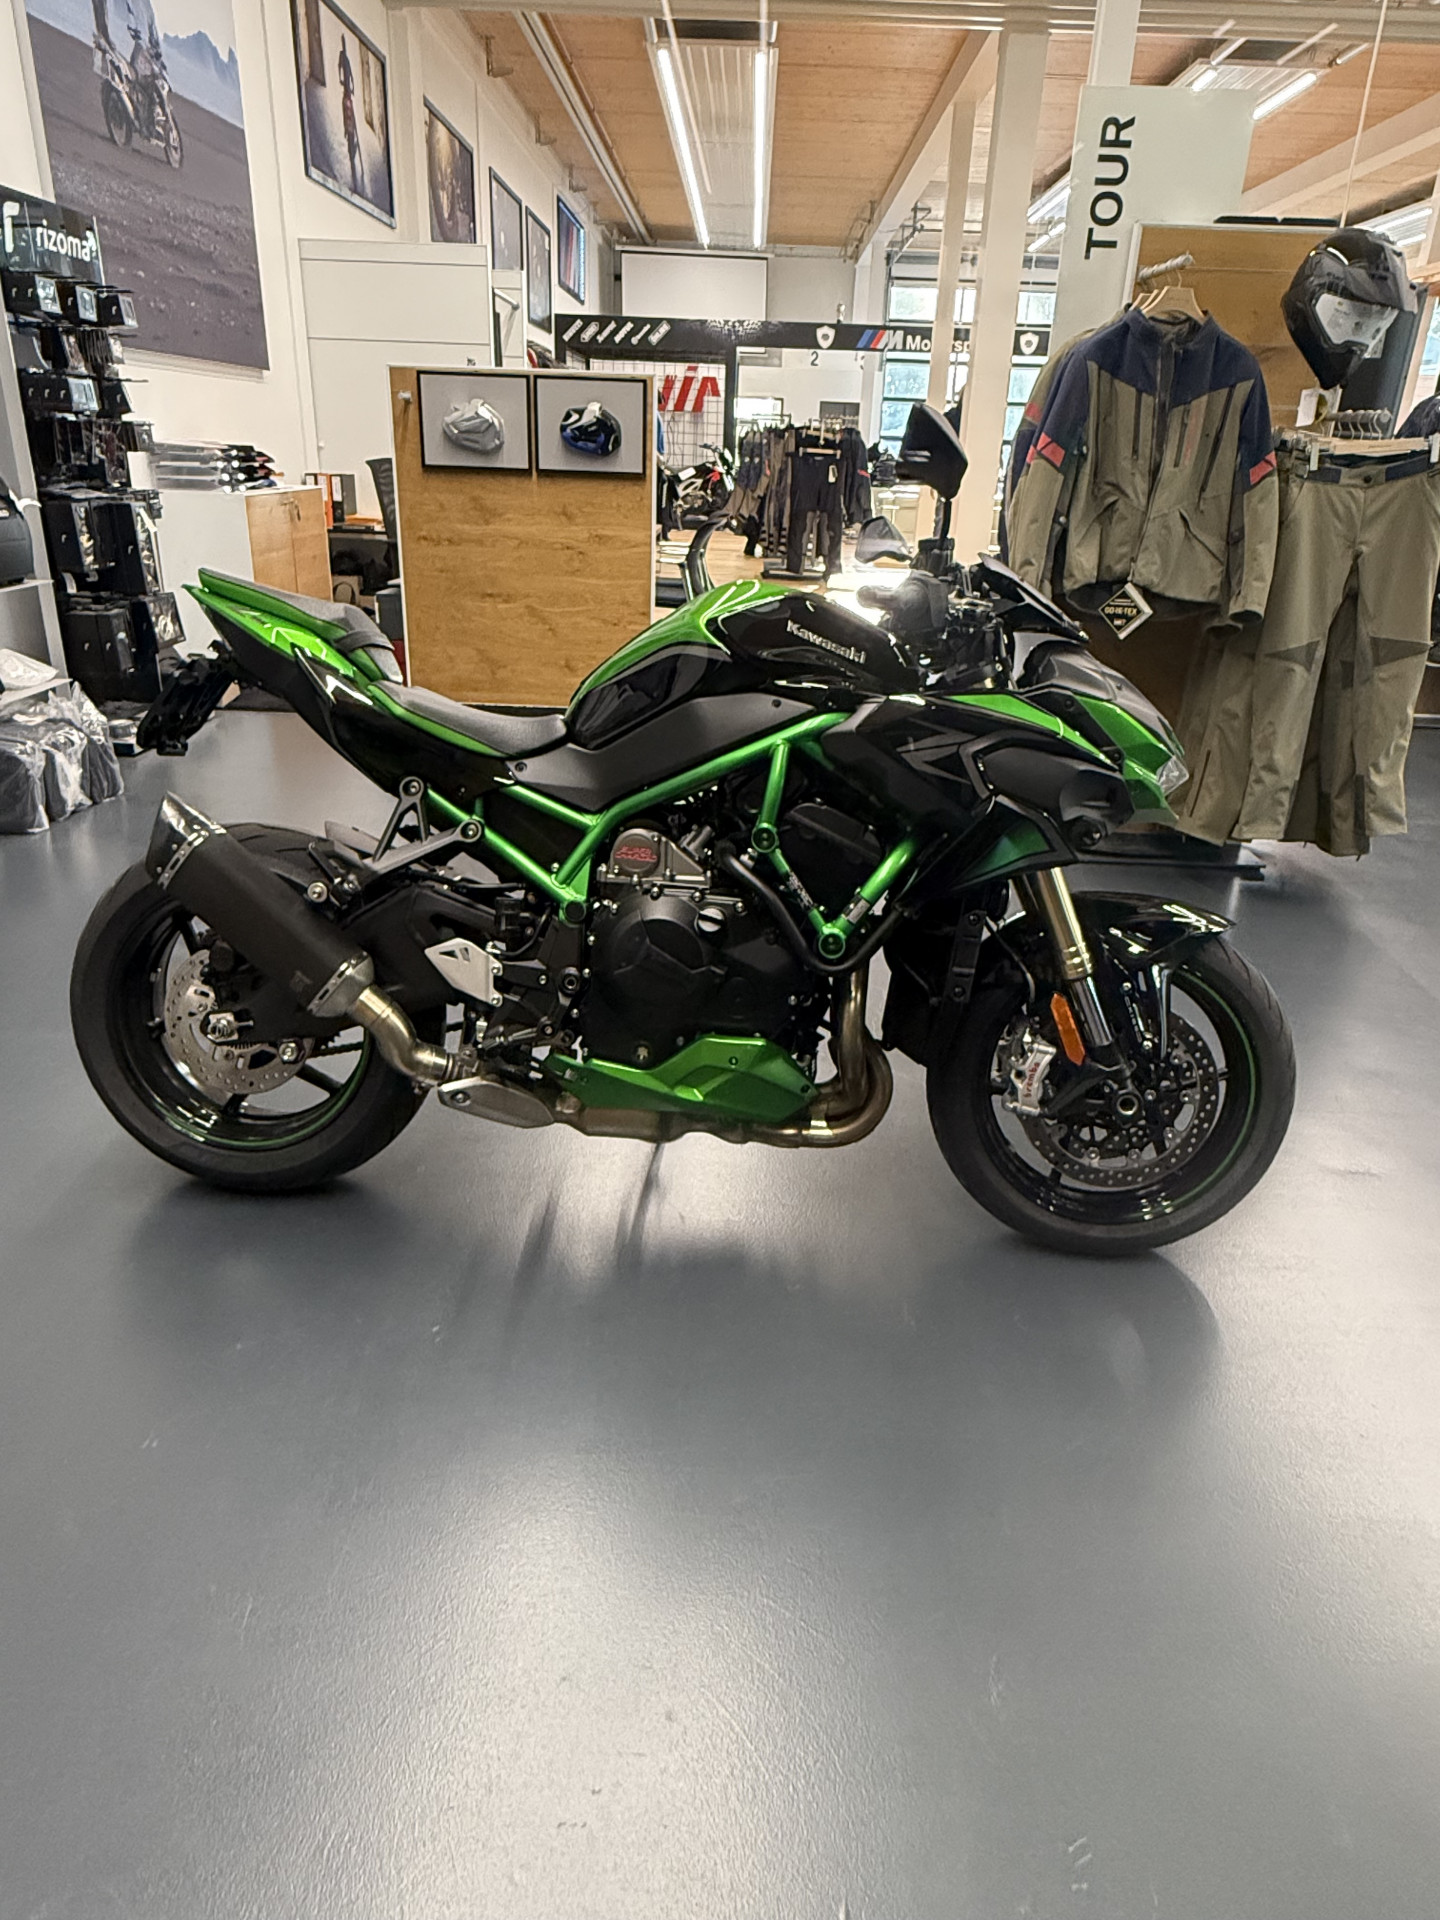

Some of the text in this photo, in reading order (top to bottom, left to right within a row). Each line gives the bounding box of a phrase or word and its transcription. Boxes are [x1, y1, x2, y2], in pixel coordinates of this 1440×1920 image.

[1084, 116, 1136, 260] TOUR
[36, 219, 91, 262] rizoma
[810, 351, 819, 366] 2
[786, 619, 866, 664] Kawasaki
